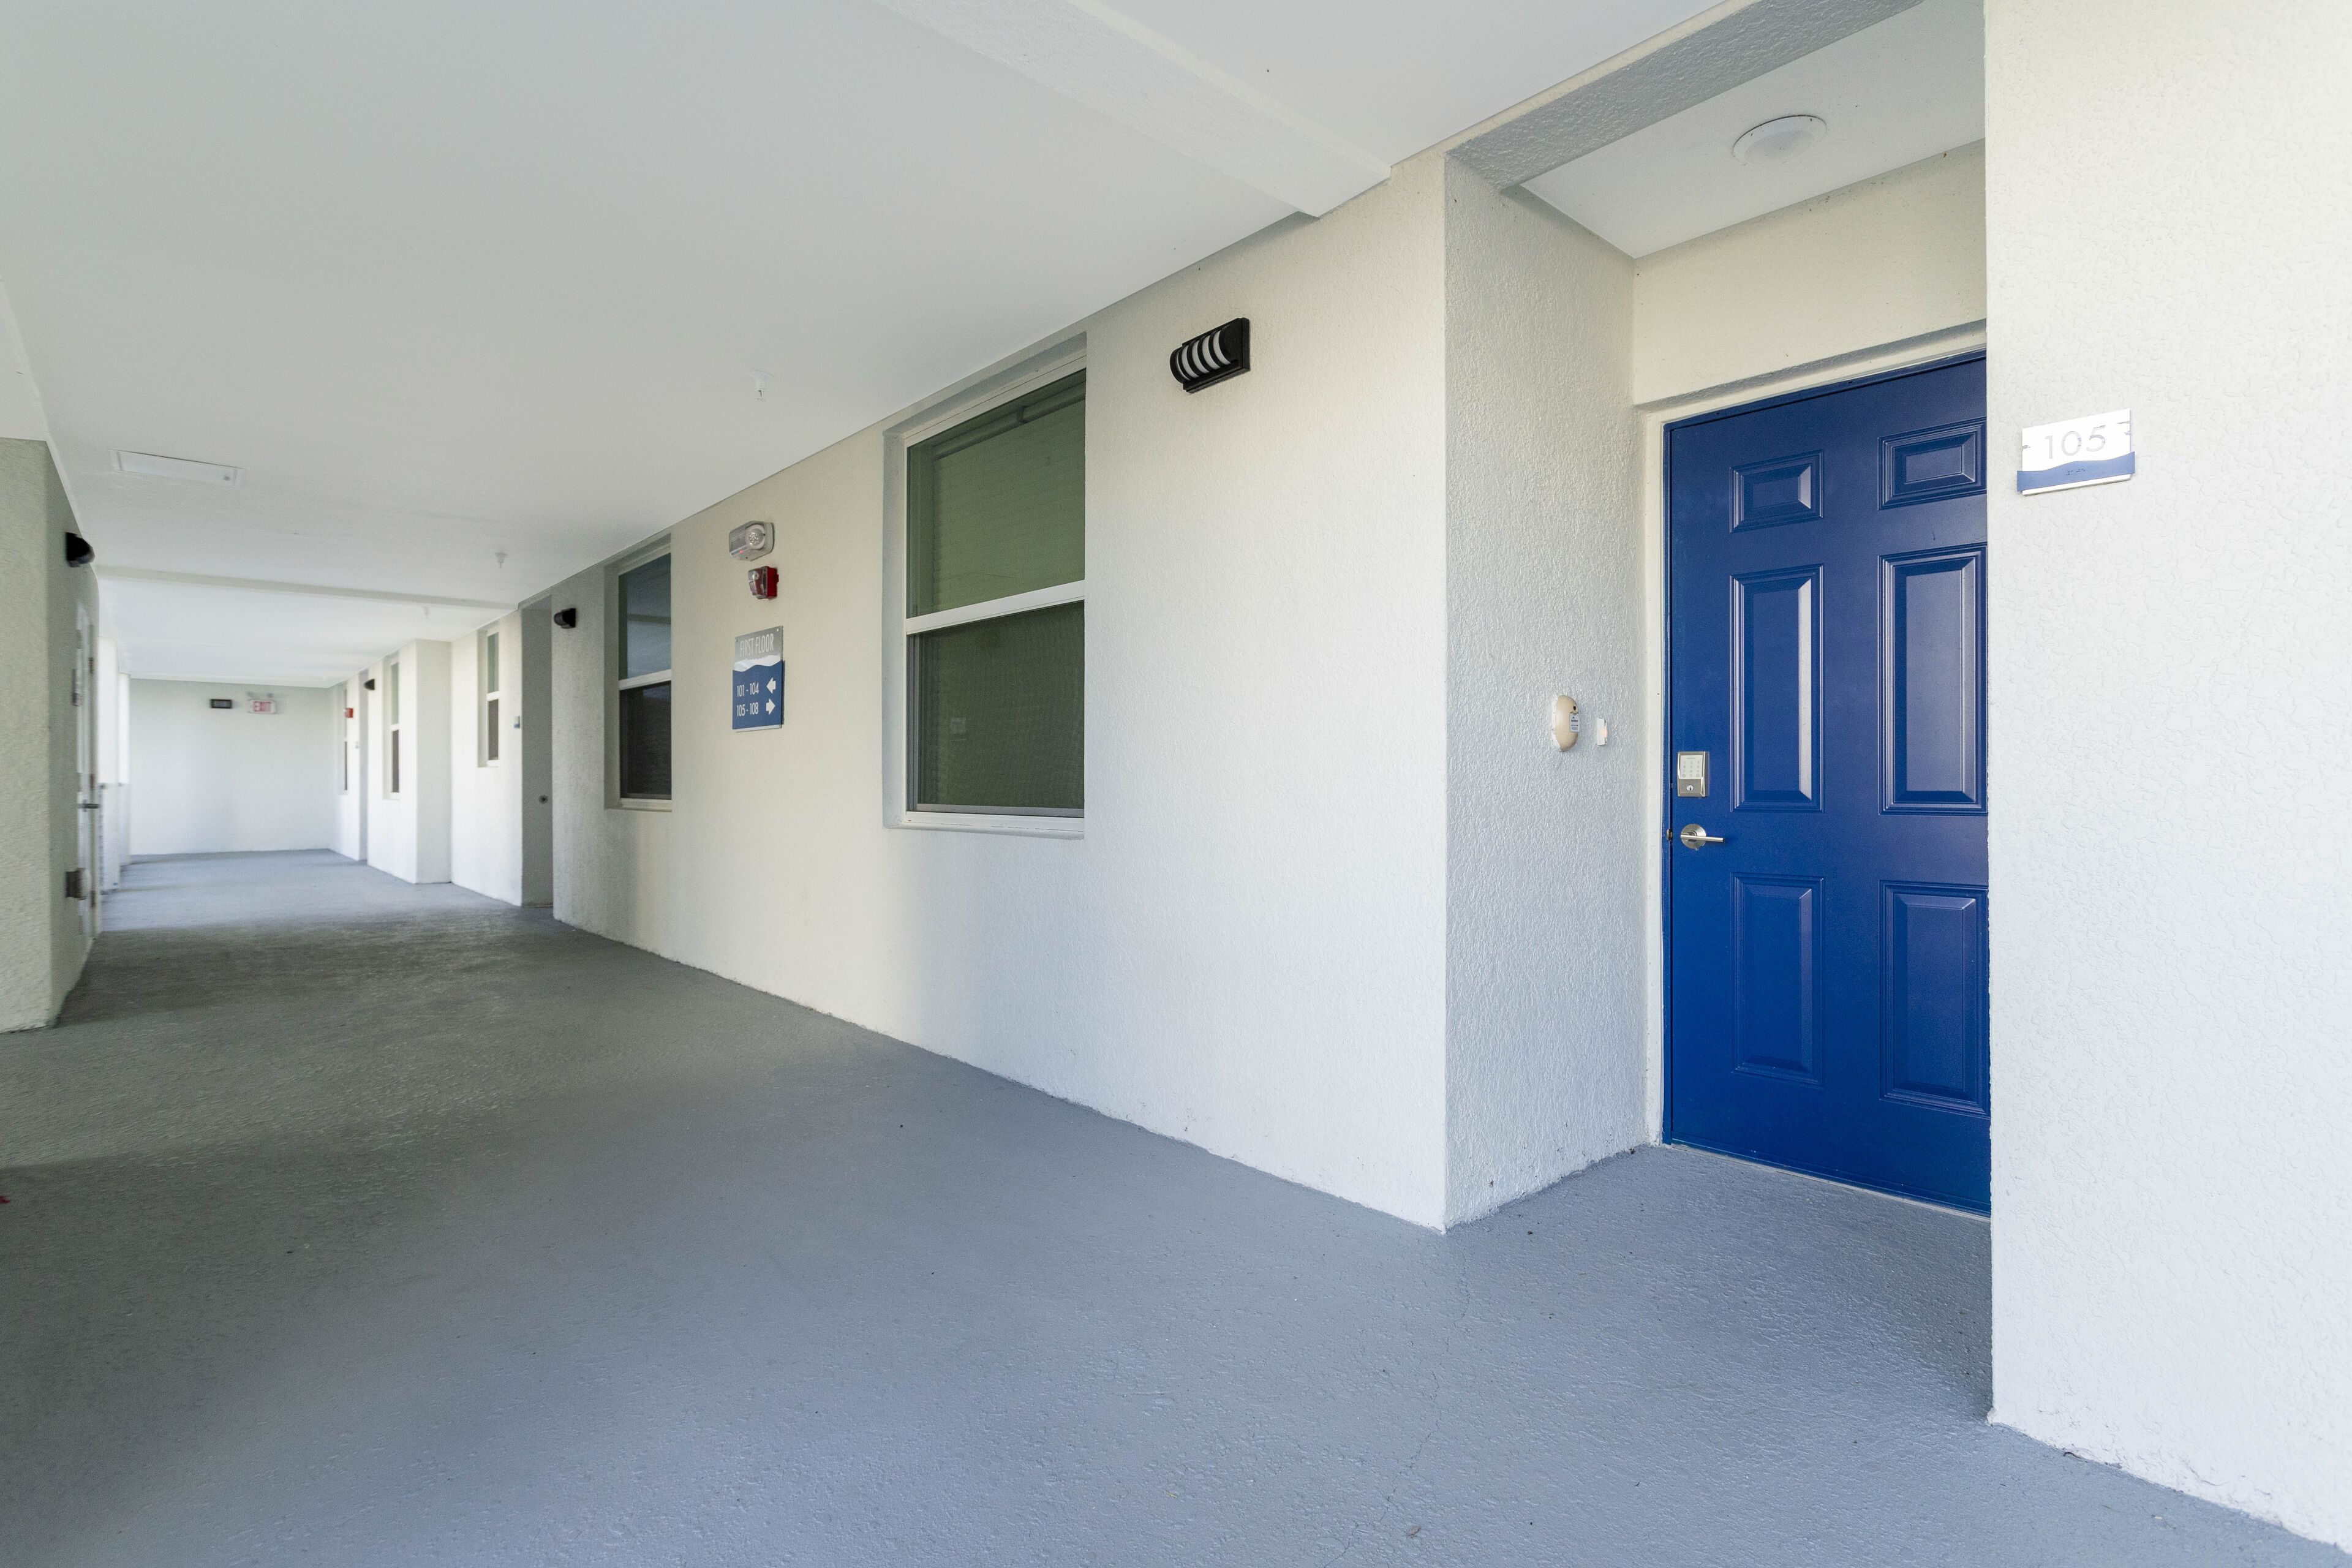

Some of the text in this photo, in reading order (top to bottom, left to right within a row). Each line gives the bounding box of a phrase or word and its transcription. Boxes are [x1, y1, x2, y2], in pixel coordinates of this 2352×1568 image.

[2045, 424, 2106, 459] 105
[739, 633, 774, 657] FIRST FLOOR
[750, 682, 759, 695] 104
[750, 702, 758, 715] 108
